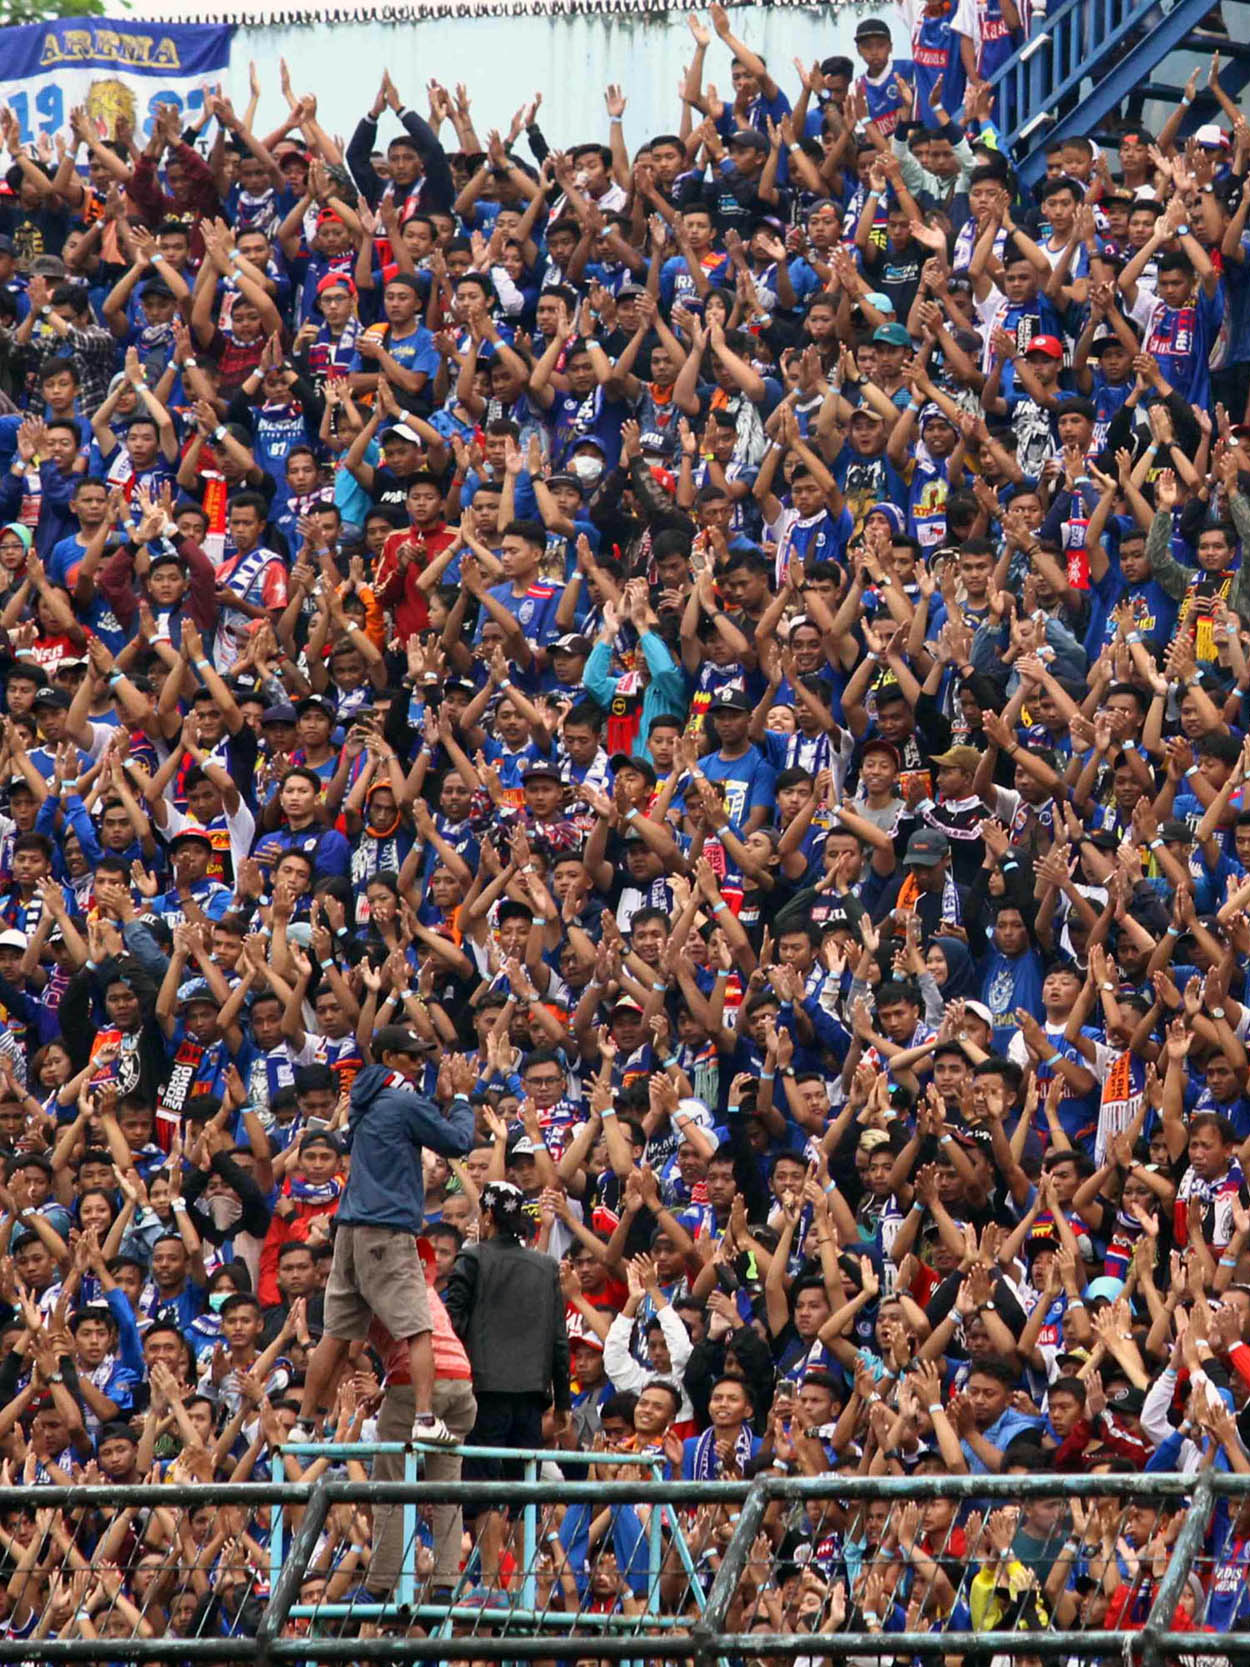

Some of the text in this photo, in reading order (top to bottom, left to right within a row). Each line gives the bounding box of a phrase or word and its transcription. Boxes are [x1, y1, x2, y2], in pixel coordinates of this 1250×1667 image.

[40, 29, 181, 69] AREMA
[8, 83, 65, 143] 19
[271, 441, 286, 456] 87
